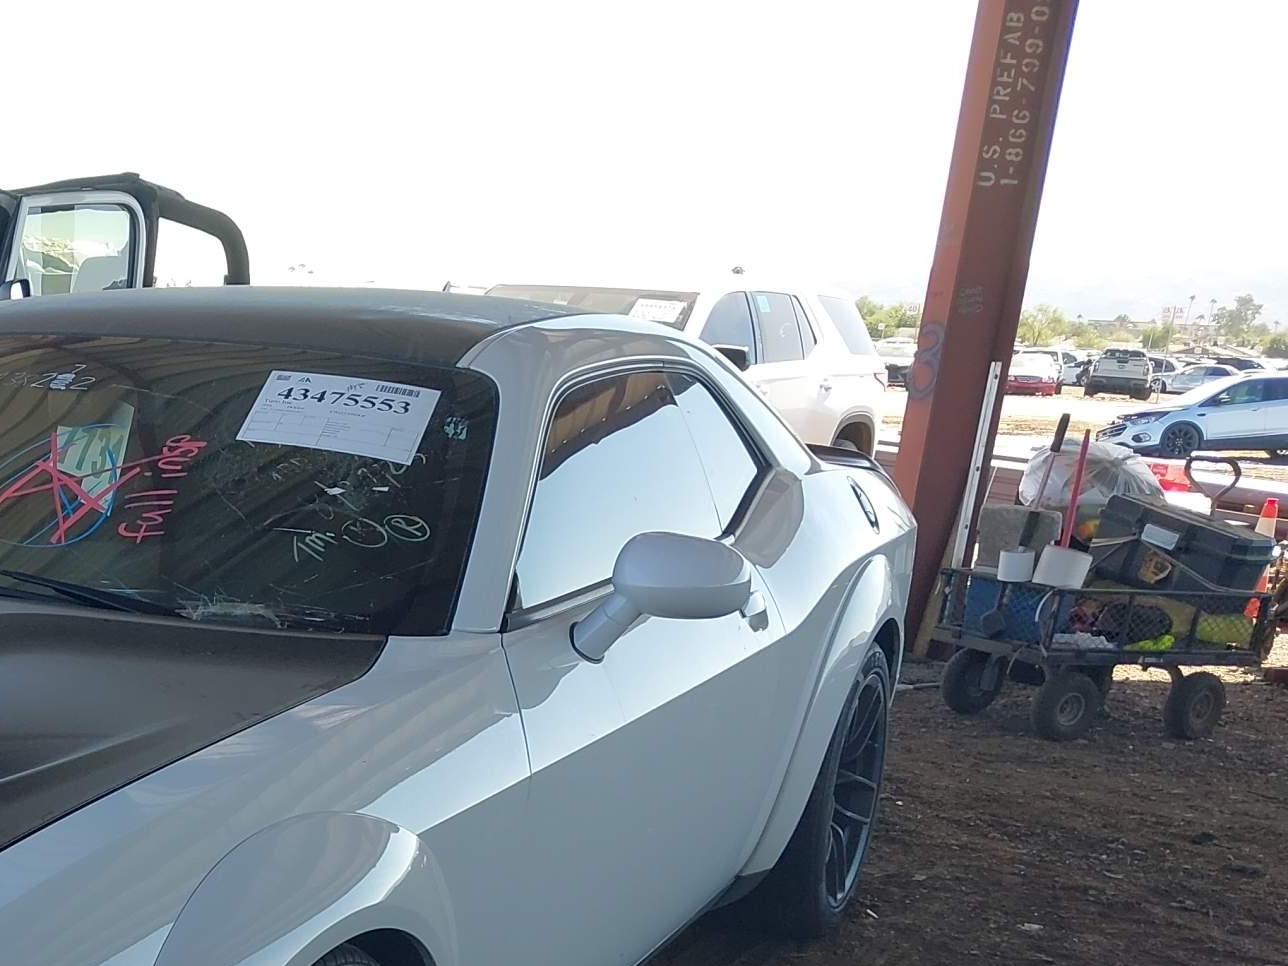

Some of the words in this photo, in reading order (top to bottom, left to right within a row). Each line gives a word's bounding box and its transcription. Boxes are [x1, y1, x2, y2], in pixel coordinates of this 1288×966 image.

[990, 12, 1025, 119] PREFAB
[999, 0, 1050, 185] 1-866-799-0
[977, 137, 1004, 187] U.S.
[277, 386, 412, 416] 43475553
[142, 433, 208, 479] insp
[117, 487, 180, 545] full
